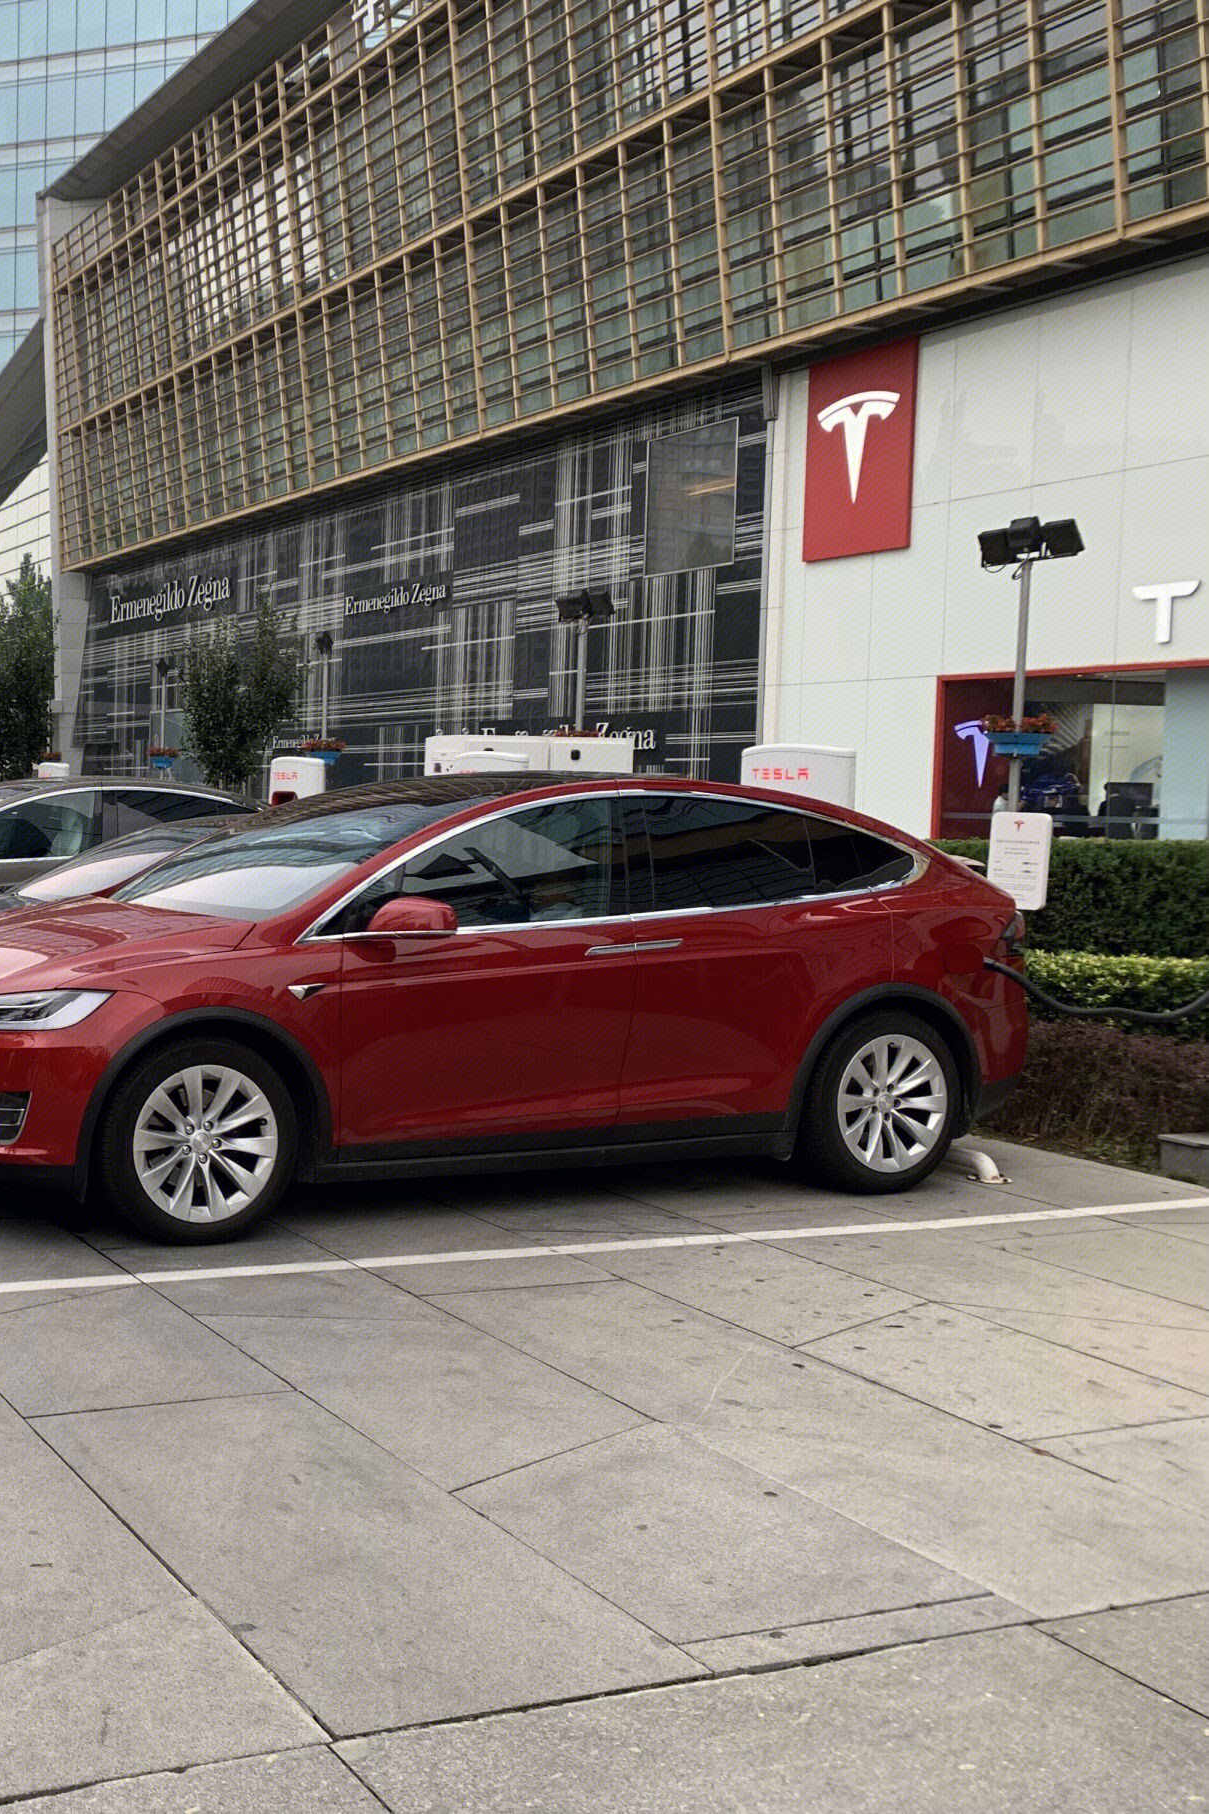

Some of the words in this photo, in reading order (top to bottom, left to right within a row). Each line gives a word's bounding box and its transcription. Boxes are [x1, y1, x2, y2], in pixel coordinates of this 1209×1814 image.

[109, 580, 185, 624] Ermenegildo
[187, 575, 230, 611] Zegna
[345, 586, 409, 615] Ermenegildo
[411, 583, 446, 606] Zegna
[273, 772, 298, 781] TESLA
[752, 767, 809, 781] TESLA
